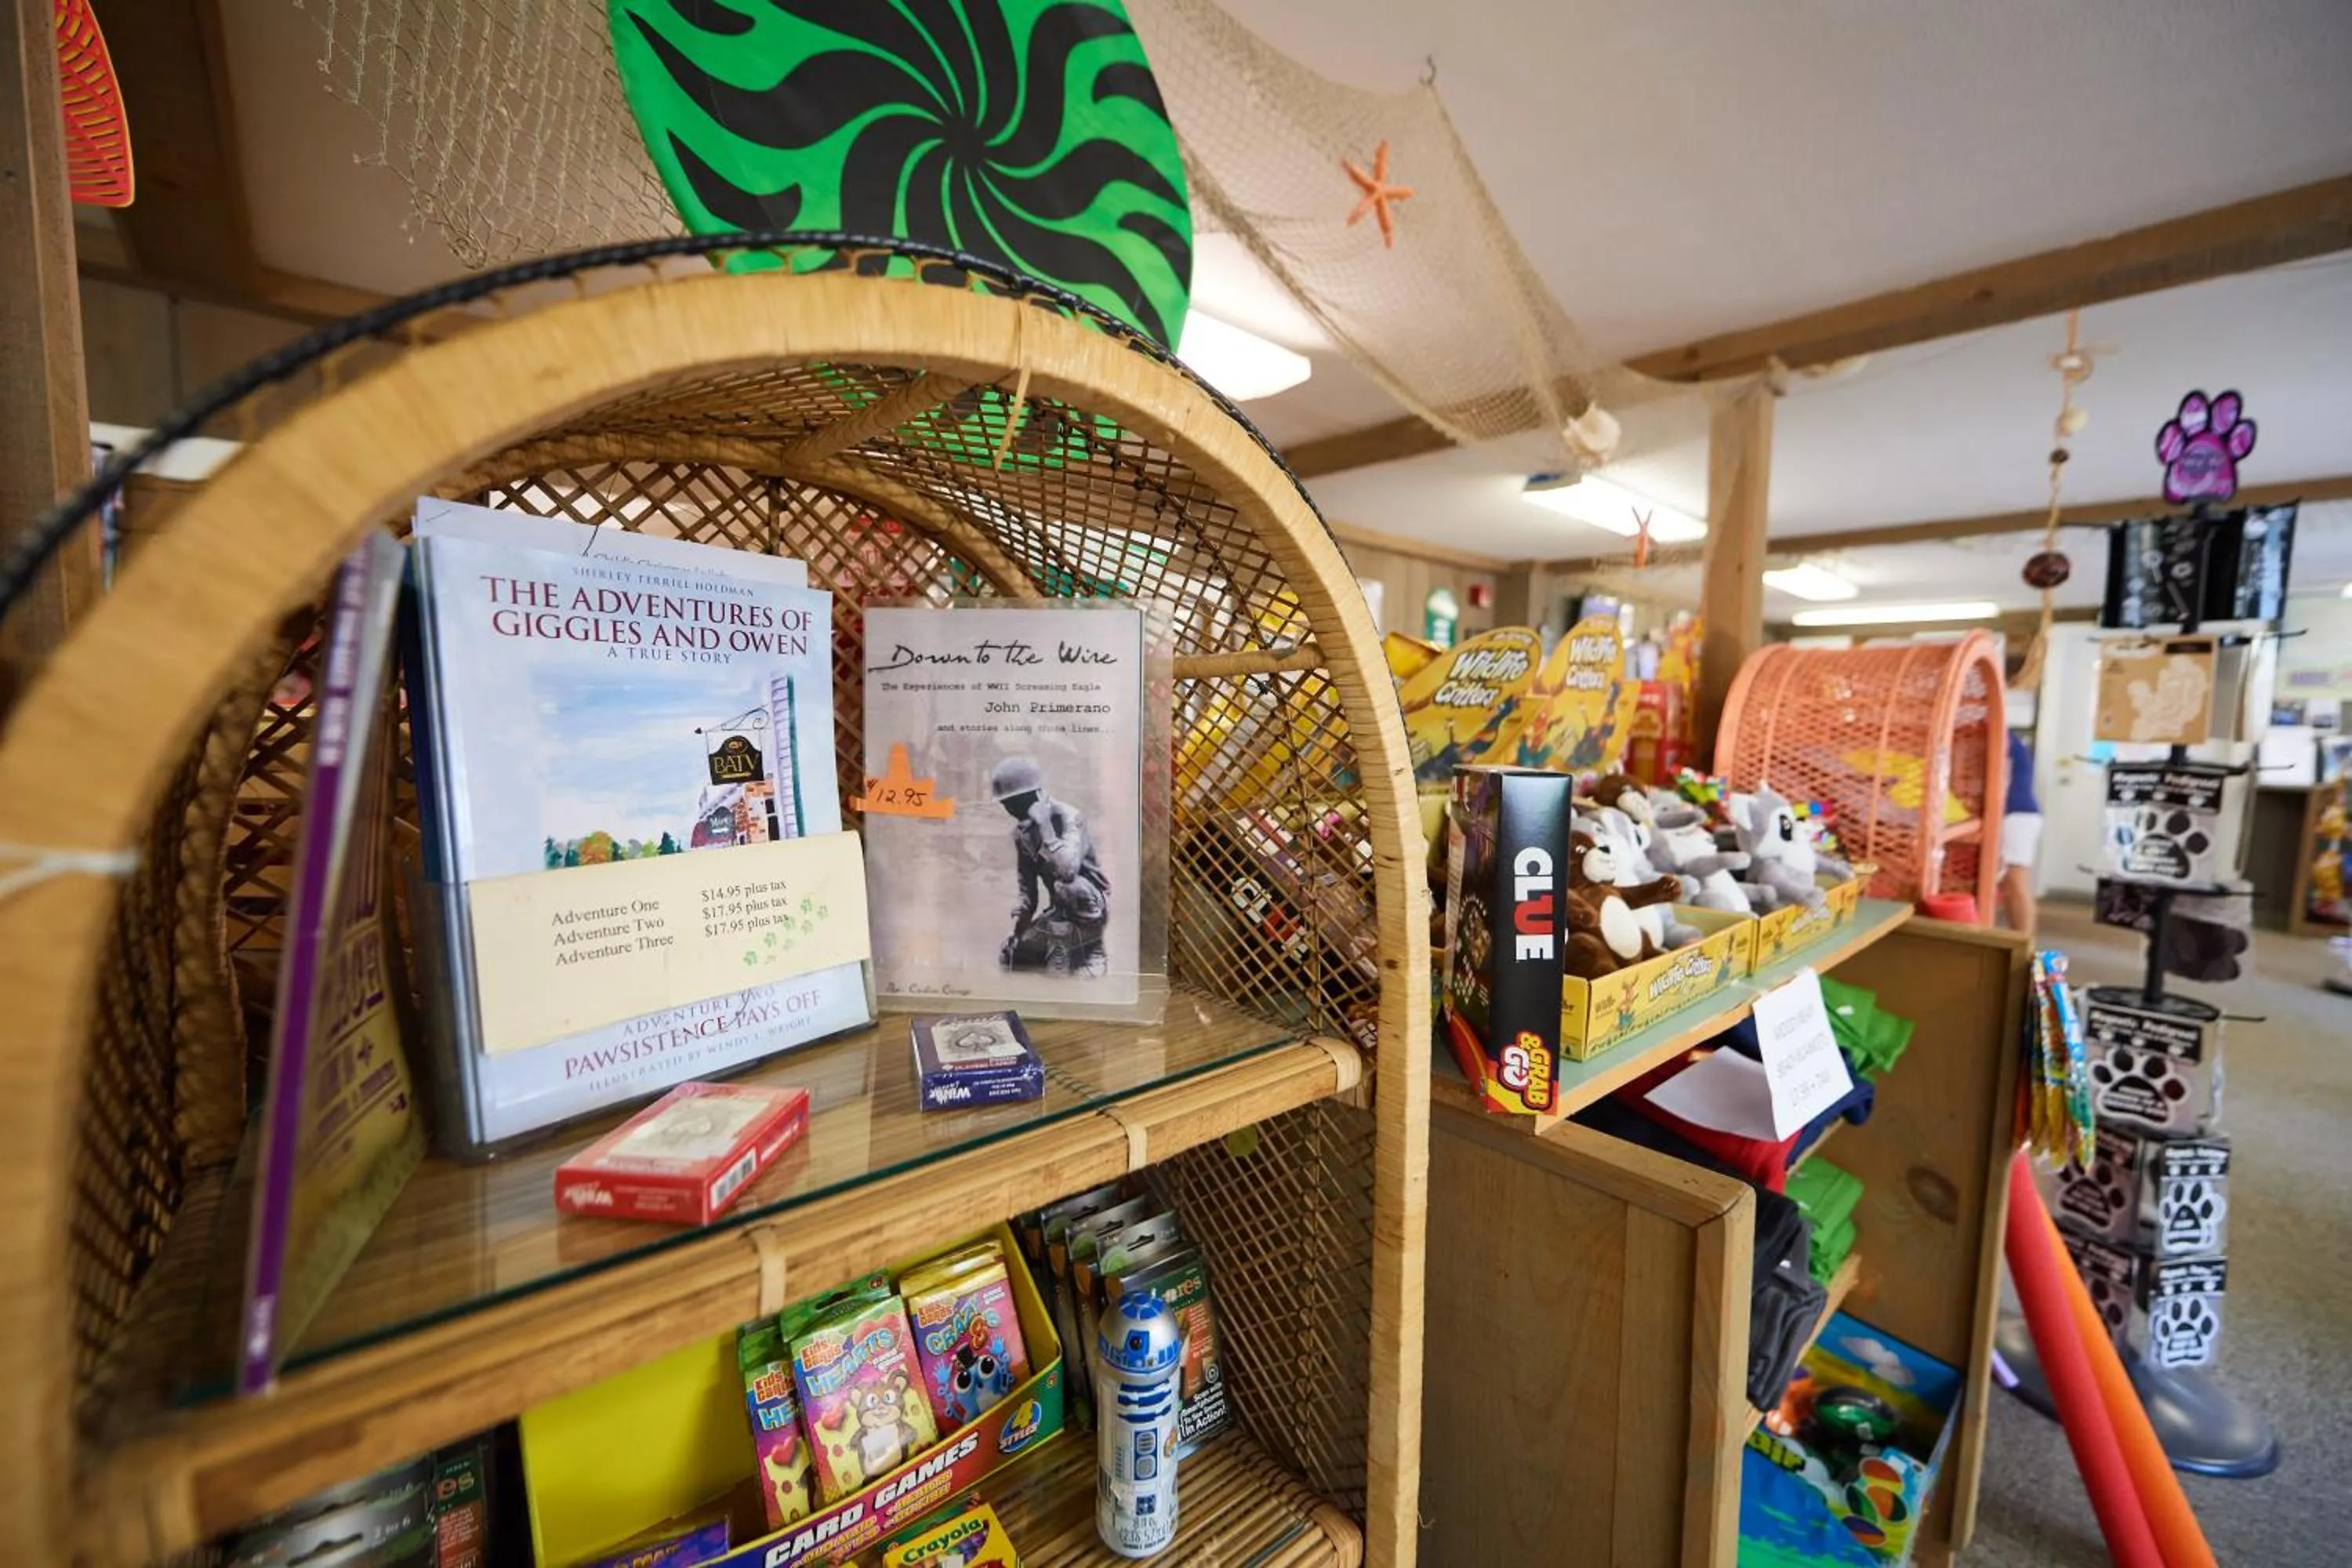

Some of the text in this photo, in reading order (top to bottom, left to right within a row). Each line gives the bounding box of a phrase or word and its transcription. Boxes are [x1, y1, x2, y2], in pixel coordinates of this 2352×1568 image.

[572, 566, 754, 597] SHIRLEY TERRILL HOLDMAN
[479, 575, 813, 632] THE ADVENTURES OF
[492, 609, 808, 656] GIGGLES AND OWEN
[608, 648, 732, 665] A TRUE STORY
[868, 644, 971, 672] Down
[974, 641, 1002, 664] to
[1059, 641, 1117, 665] Wire
[1450, 648, 1530, 681] Wildlife
[881, 682, 1102, 693] The Experiences of WWII Screaming Eagle
[985, 702, 1111, 714] John Primerano
[1433, 682, 1498, 706] Critters
[937, 724, 954, 732] and
[960, 724, 998, 732] stories
[1004, 724, 1032, 735] along
[551, 878, 788, 927] Adventure One $14.95 plus tax
[554, 895, 789, 947] Adventure Two $17.95 plus tax
[1514, 846, 1554, 961] CLUE
[555, 913, 789, 967] Adventure Three $17.95 plus tax
[564, 989, 822, 1080] PAWSISTENCE PAYS OFF
[623, 996, 731, 1036] ADVENTURE
[590, 1057, 683, 1093] ILLUSTRATED
[688, 1051, 703, 1065] BY
[1529, 1048, 1552, 1108] GRAB
[806, 1329, 894, 1396] HEARTS
[1011, 1399, 1033, 1428] 4
[764, 1503, 864, 1568] CARD
[873, 1432, 979, 1510] GAMES
[903, 1519, 983, 1563] Crayola
